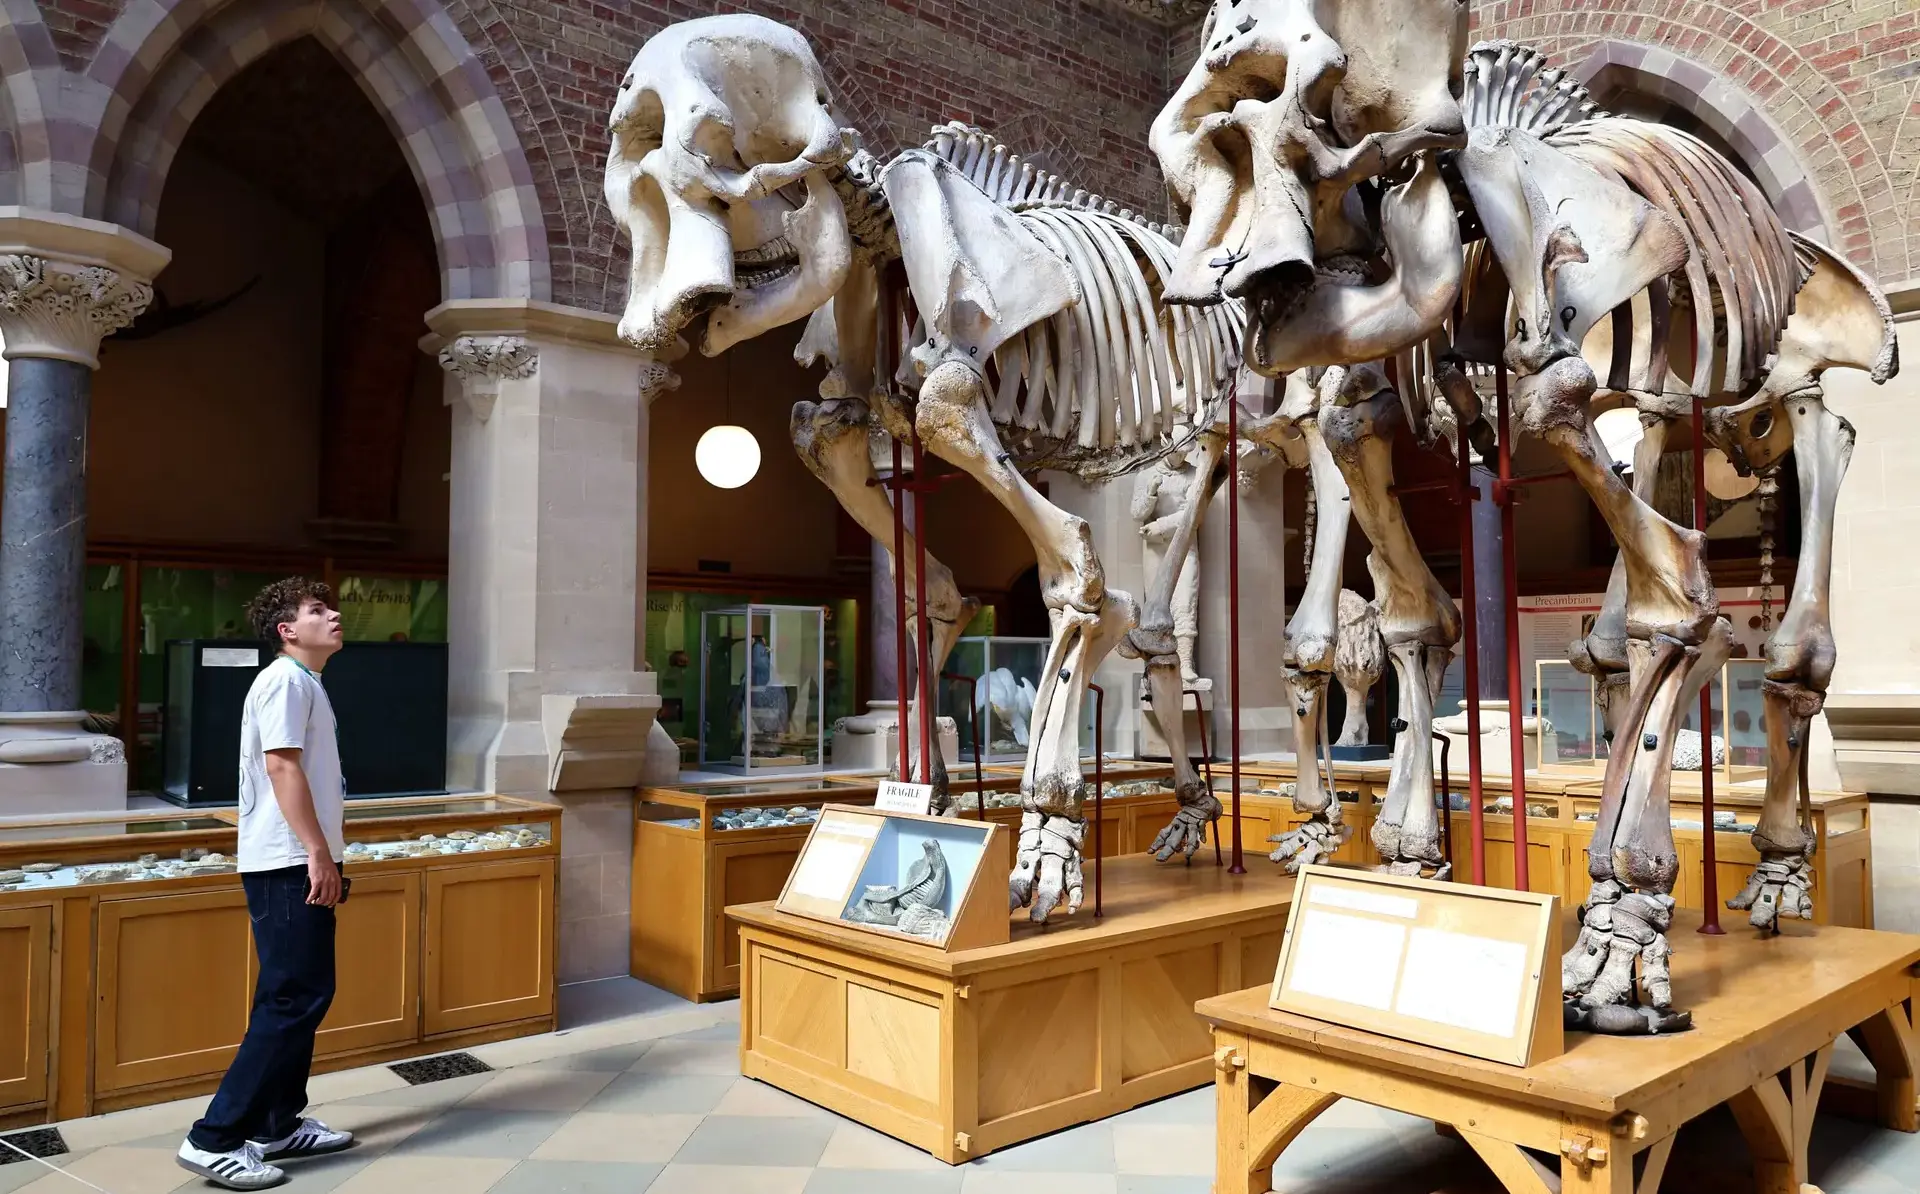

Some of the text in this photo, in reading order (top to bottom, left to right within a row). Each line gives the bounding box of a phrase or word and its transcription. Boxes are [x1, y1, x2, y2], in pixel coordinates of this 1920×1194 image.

[647, 599, 668, 612] Rise
[1535, 595, 1592, 606] Precambrian
[886, 786, 922, 798] FRAGILE
